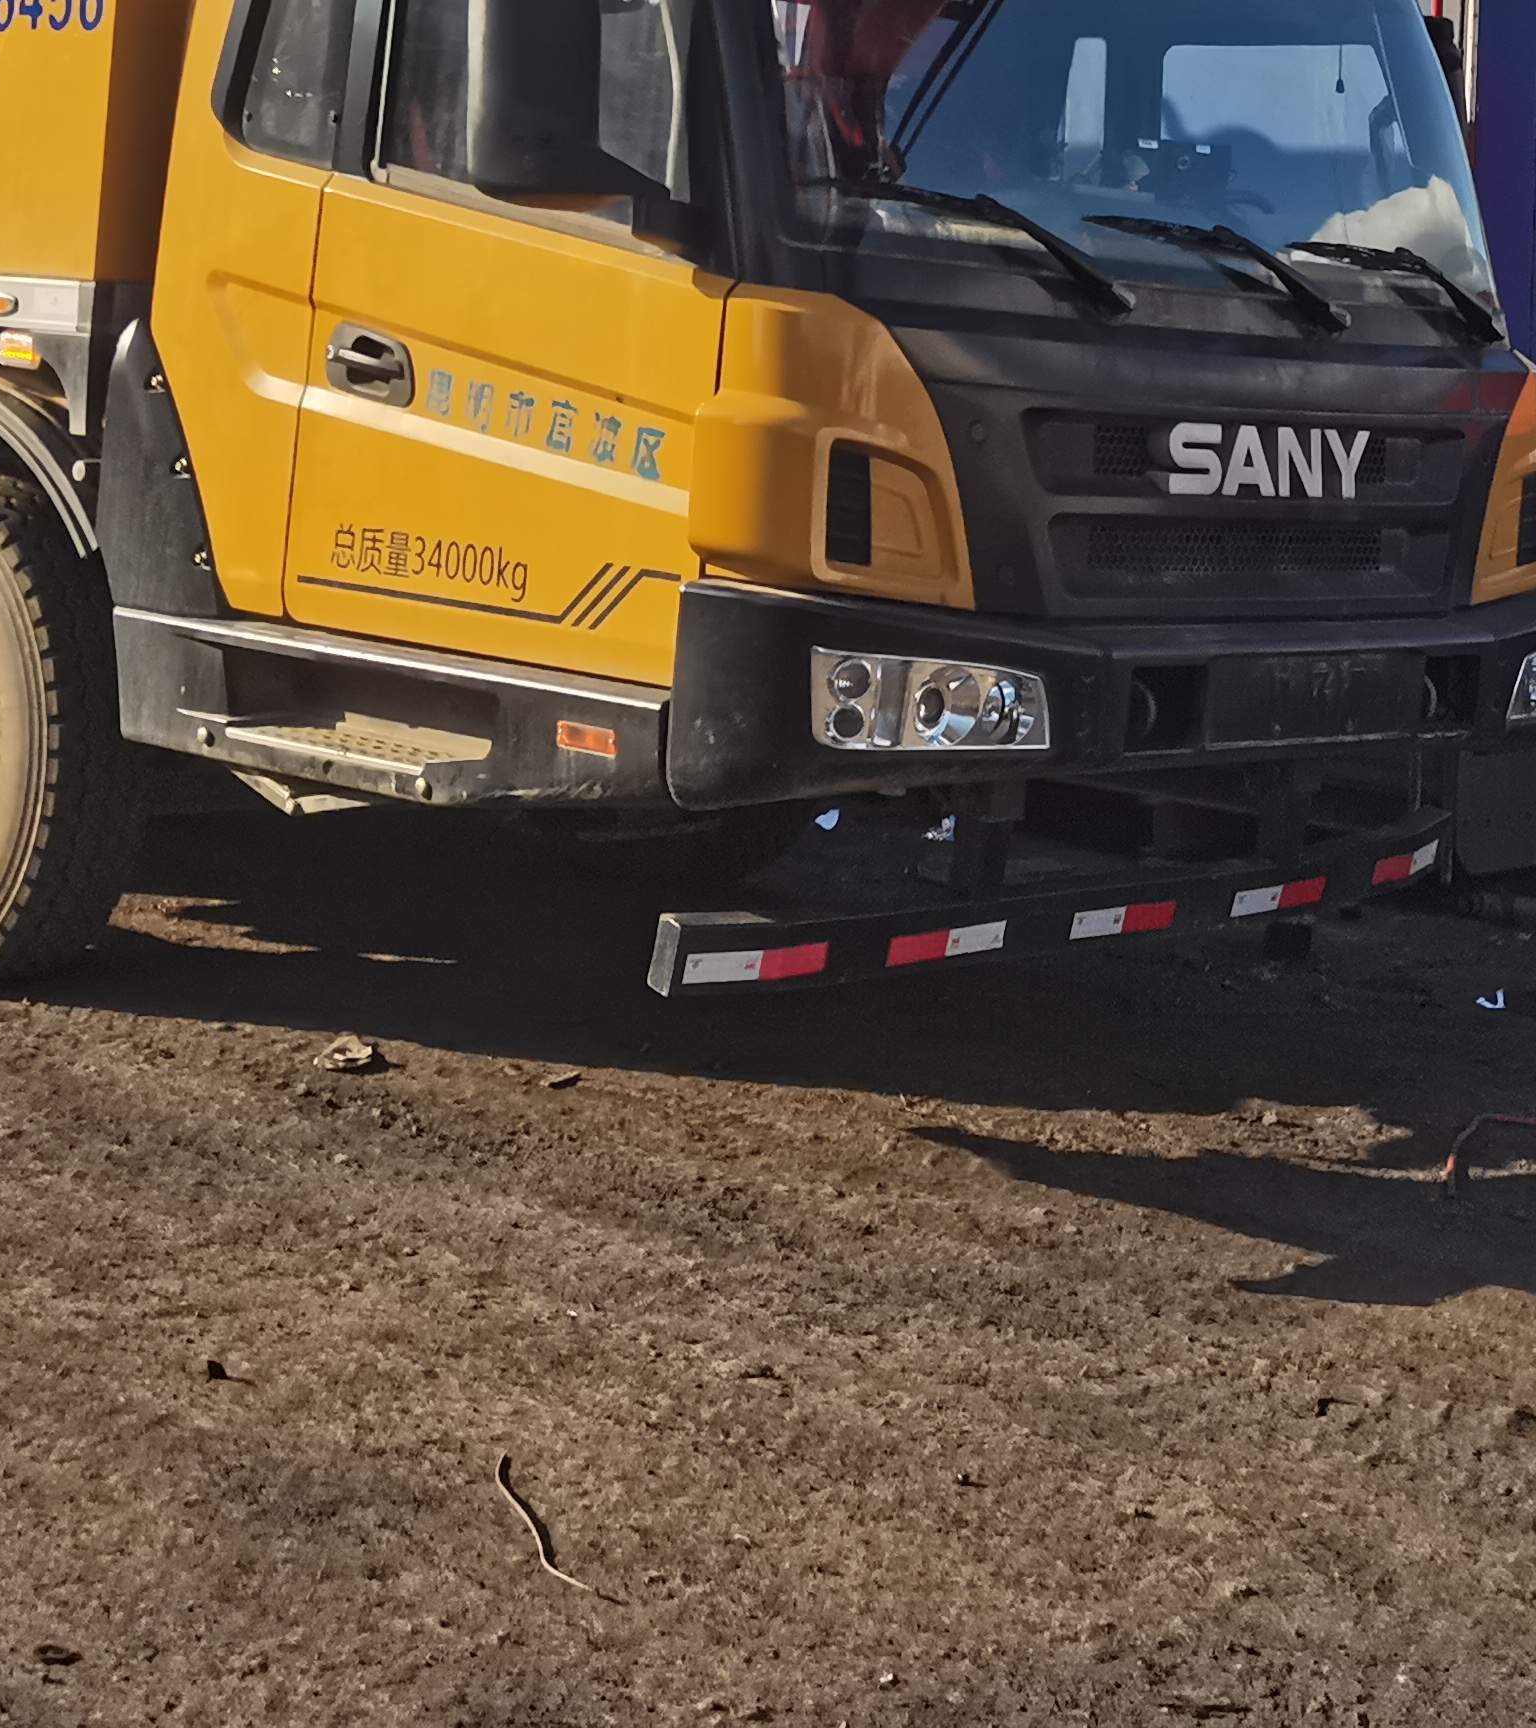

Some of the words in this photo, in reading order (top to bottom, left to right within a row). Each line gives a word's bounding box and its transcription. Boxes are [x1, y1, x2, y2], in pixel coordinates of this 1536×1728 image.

[1168, 421, 1371, 500] SANY
[330, 523, 529, 603] 总质量34000kg
